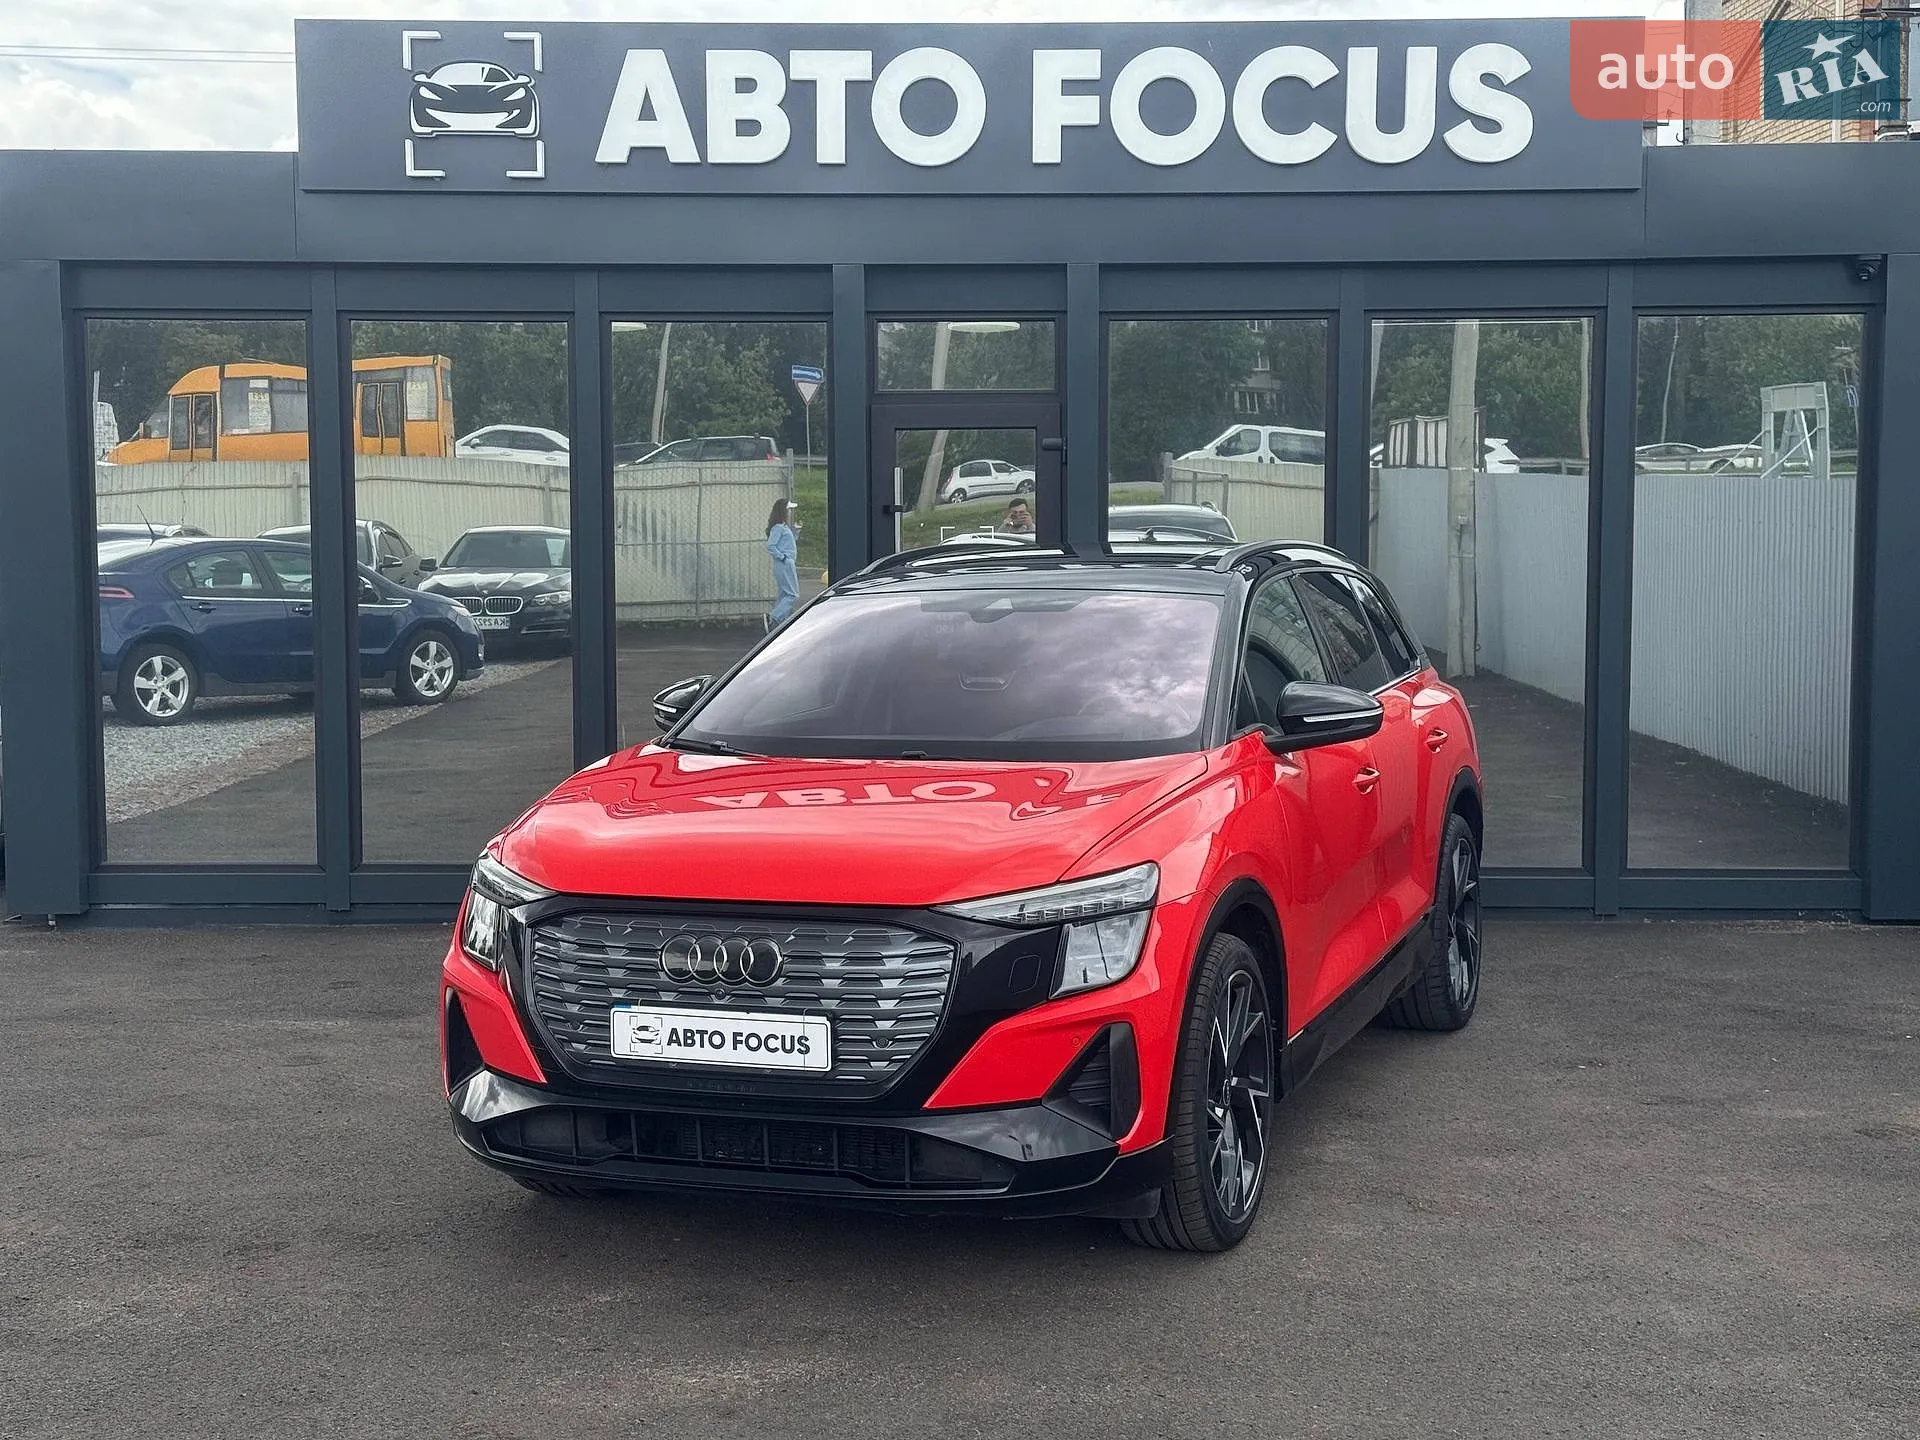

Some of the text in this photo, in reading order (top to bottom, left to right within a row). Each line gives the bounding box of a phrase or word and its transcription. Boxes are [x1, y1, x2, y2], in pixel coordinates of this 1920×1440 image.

[595, 44, 1534, 167] АВТО FOCUS
[667, 1027, 811, 1055] АВТО FOCUS
